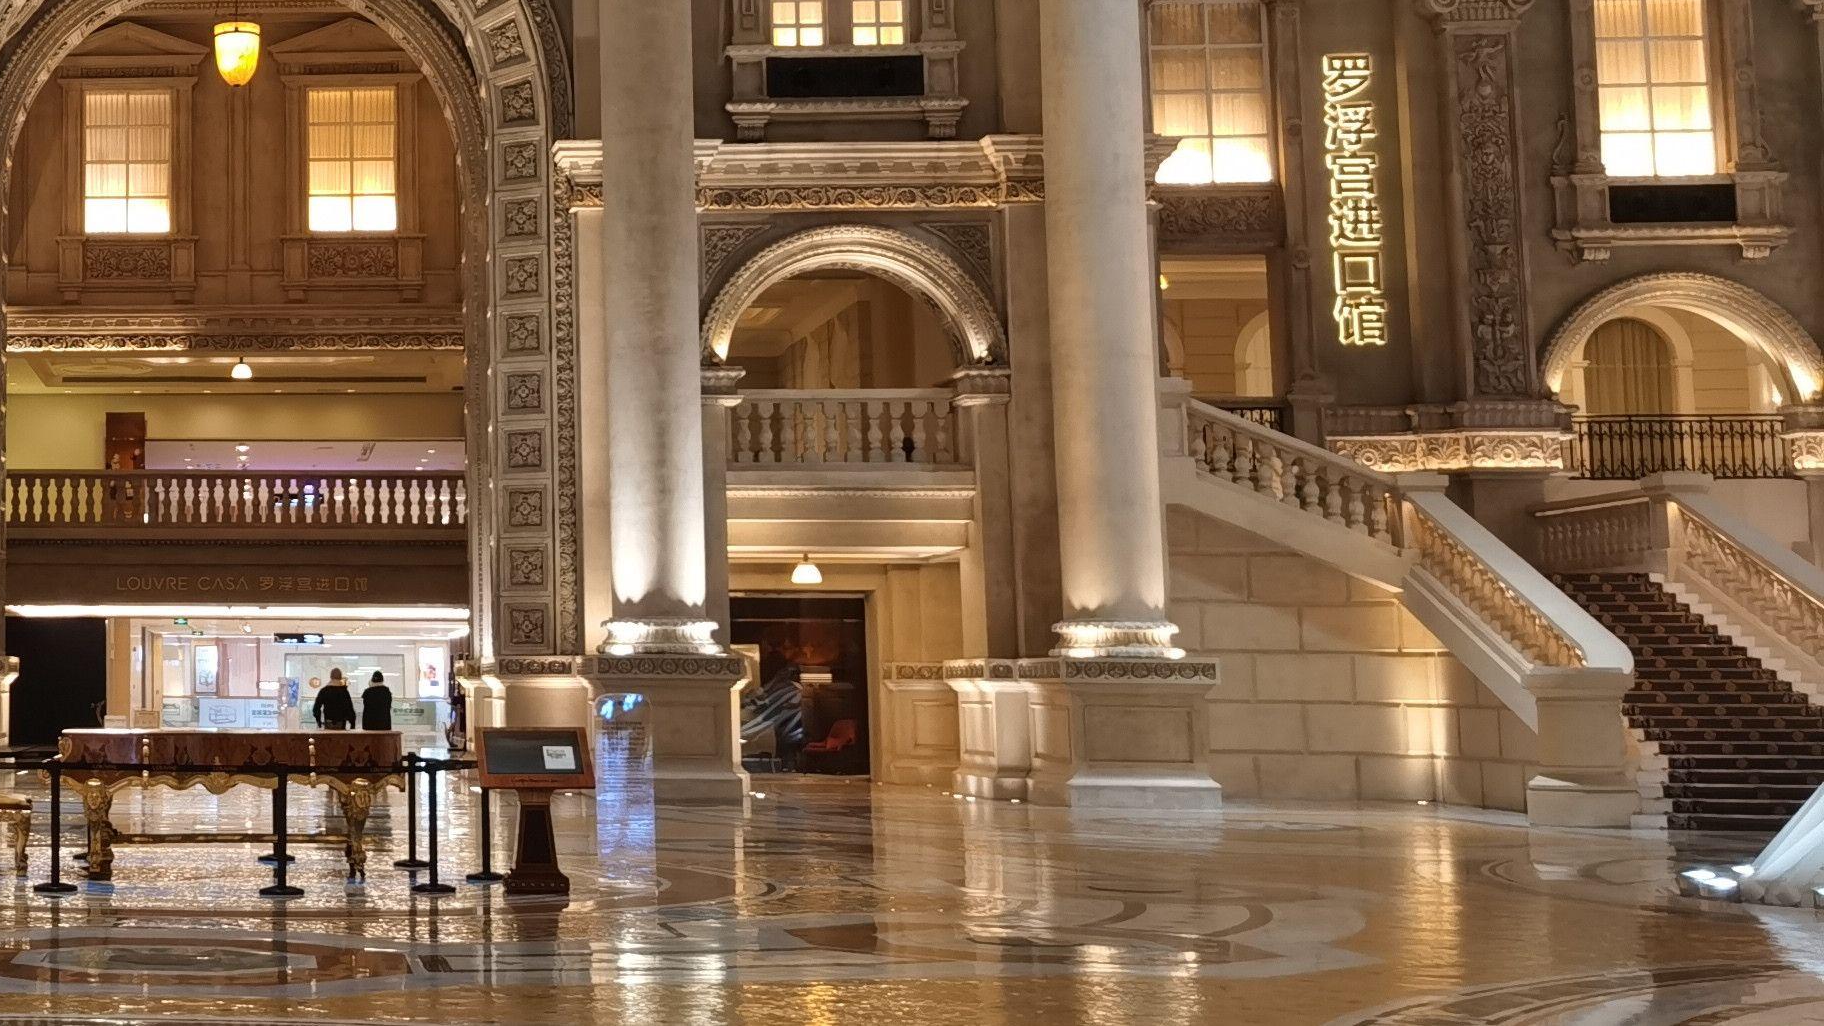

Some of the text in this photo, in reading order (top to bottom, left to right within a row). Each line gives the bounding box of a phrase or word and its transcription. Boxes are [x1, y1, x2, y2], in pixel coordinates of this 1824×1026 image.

[1323, 53, 1387, 346] 罗浮宫进口馆
[116, 576, 369, 592] LOUVRE CASA 罗浮宫进口馆
